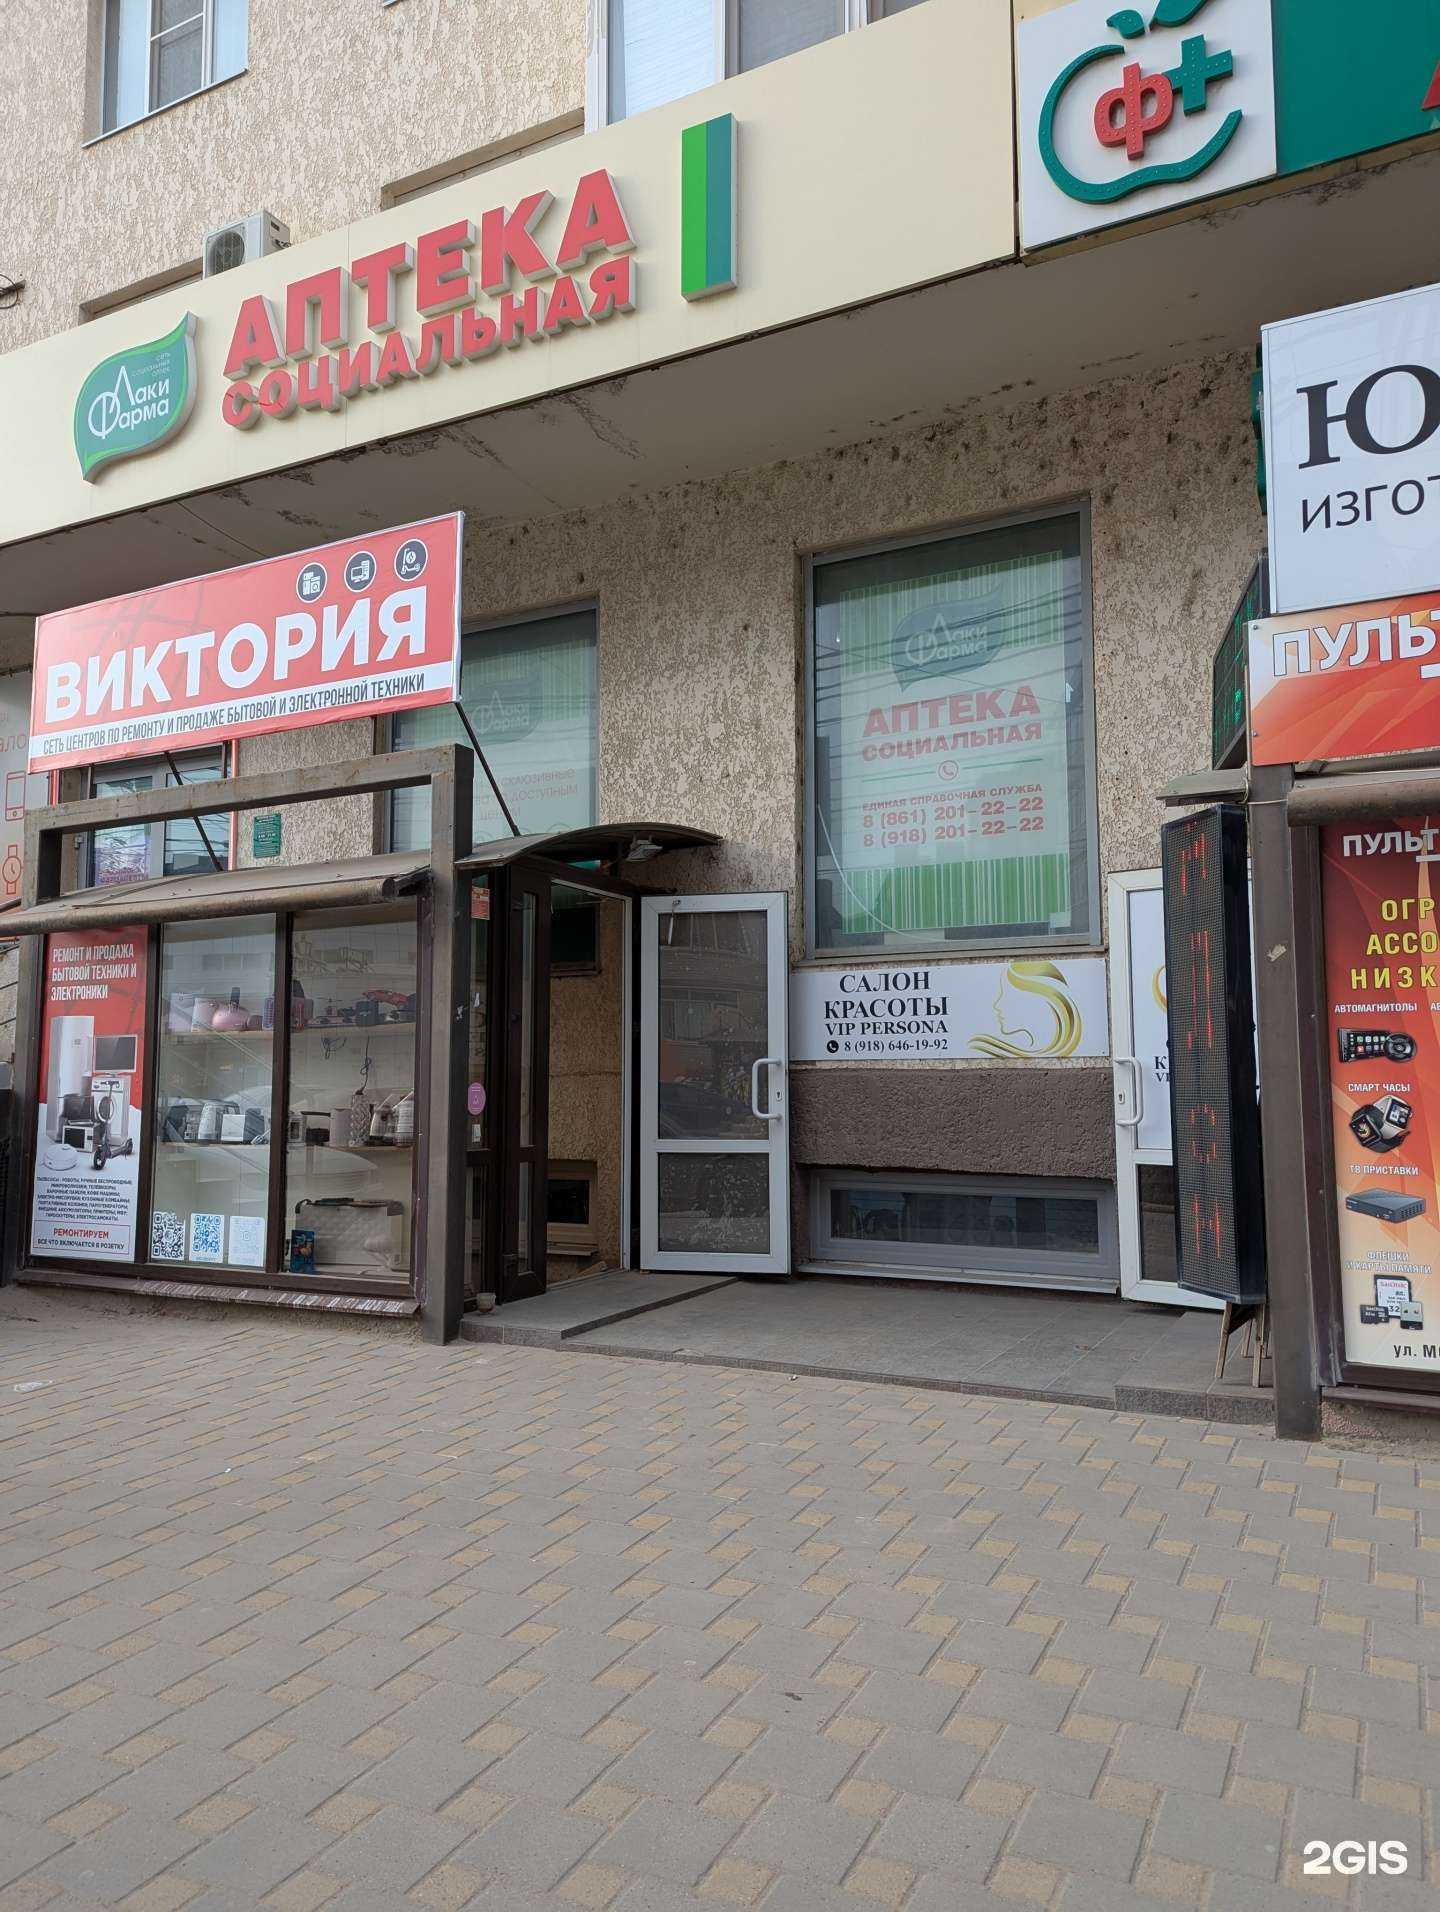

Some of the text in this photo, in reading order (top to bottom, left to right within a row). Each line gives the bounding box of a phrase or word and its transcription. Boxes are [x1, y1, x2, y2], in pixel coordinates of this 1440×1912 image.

[223, 168, 637, 380] АПТЕКА
[222, 255, 636, 431] СОЦИАЛЬНАЯ
[109, 366, 170, 414] Лаки
[88, 391, 169, 440] Фарма
[45, 585, 427, 724] ВИКТОРИЯ
[43, 673, 425, 755] СЕТЬ ЦЕНТРОВ ПО РЕМОНТУ И ПРОДАЖЕ БЫТОВОЙ И ЭЛЕКТРОННОЙ ТЕХНИКИ
[862, 685, 1041, 738] АПТЕКА
[862, 722, 1043, 762] СОЦИАЛЬНАЯ
[863, 783, 1042, 812] ЕДИНАЯ СПРАВОЧНАЯ СЛУЖБА
[863, 815, 874, 829] 8
[881, 809, 927, 829] (861)
[863, 834, 874, 848] 8
[881, 829, 927, 848] (918)
[1343, 829, 1440, 857] ПУЛЬТ
[1381, 898, 1436, 922] ОГР
[53, 944, 134, 962] РЕМОНТ И ПРОДАЖА
[1366, 931, 1438, 956] АССО
[52, 963, 137, 981] БЫТОВОЙ ТЕХНИКИ И
[839, 970, 931, 995] САЛОН
[1350, 965, 1438, 990] НИЗК
[51, 984, 108, 1001] ЭЛЕКТРОНИКИ
[824, 996, 950, 1020] КРАСОТЫ
[1334, 1002, 1418, 1014] АВТОМАГНИТОЛЫ
[825, 1020, 949, 1037] VIP PERSONA
[844, 1038, 949, 1054] 8 (918) 646-19-92
[1348, 1083, 1411, 1093] СМАРТ ЧАСЫ
[1349, 1165, 1420, 1176] ТВ ПРИСТАВКИ
[53, 1228, 109, 1239] РЕМОНТИРУЕМ
[1367, 1251, 1410, 1261] ФЛЕШКИ
[1393, 1344, 1440, 1358] ул. М
